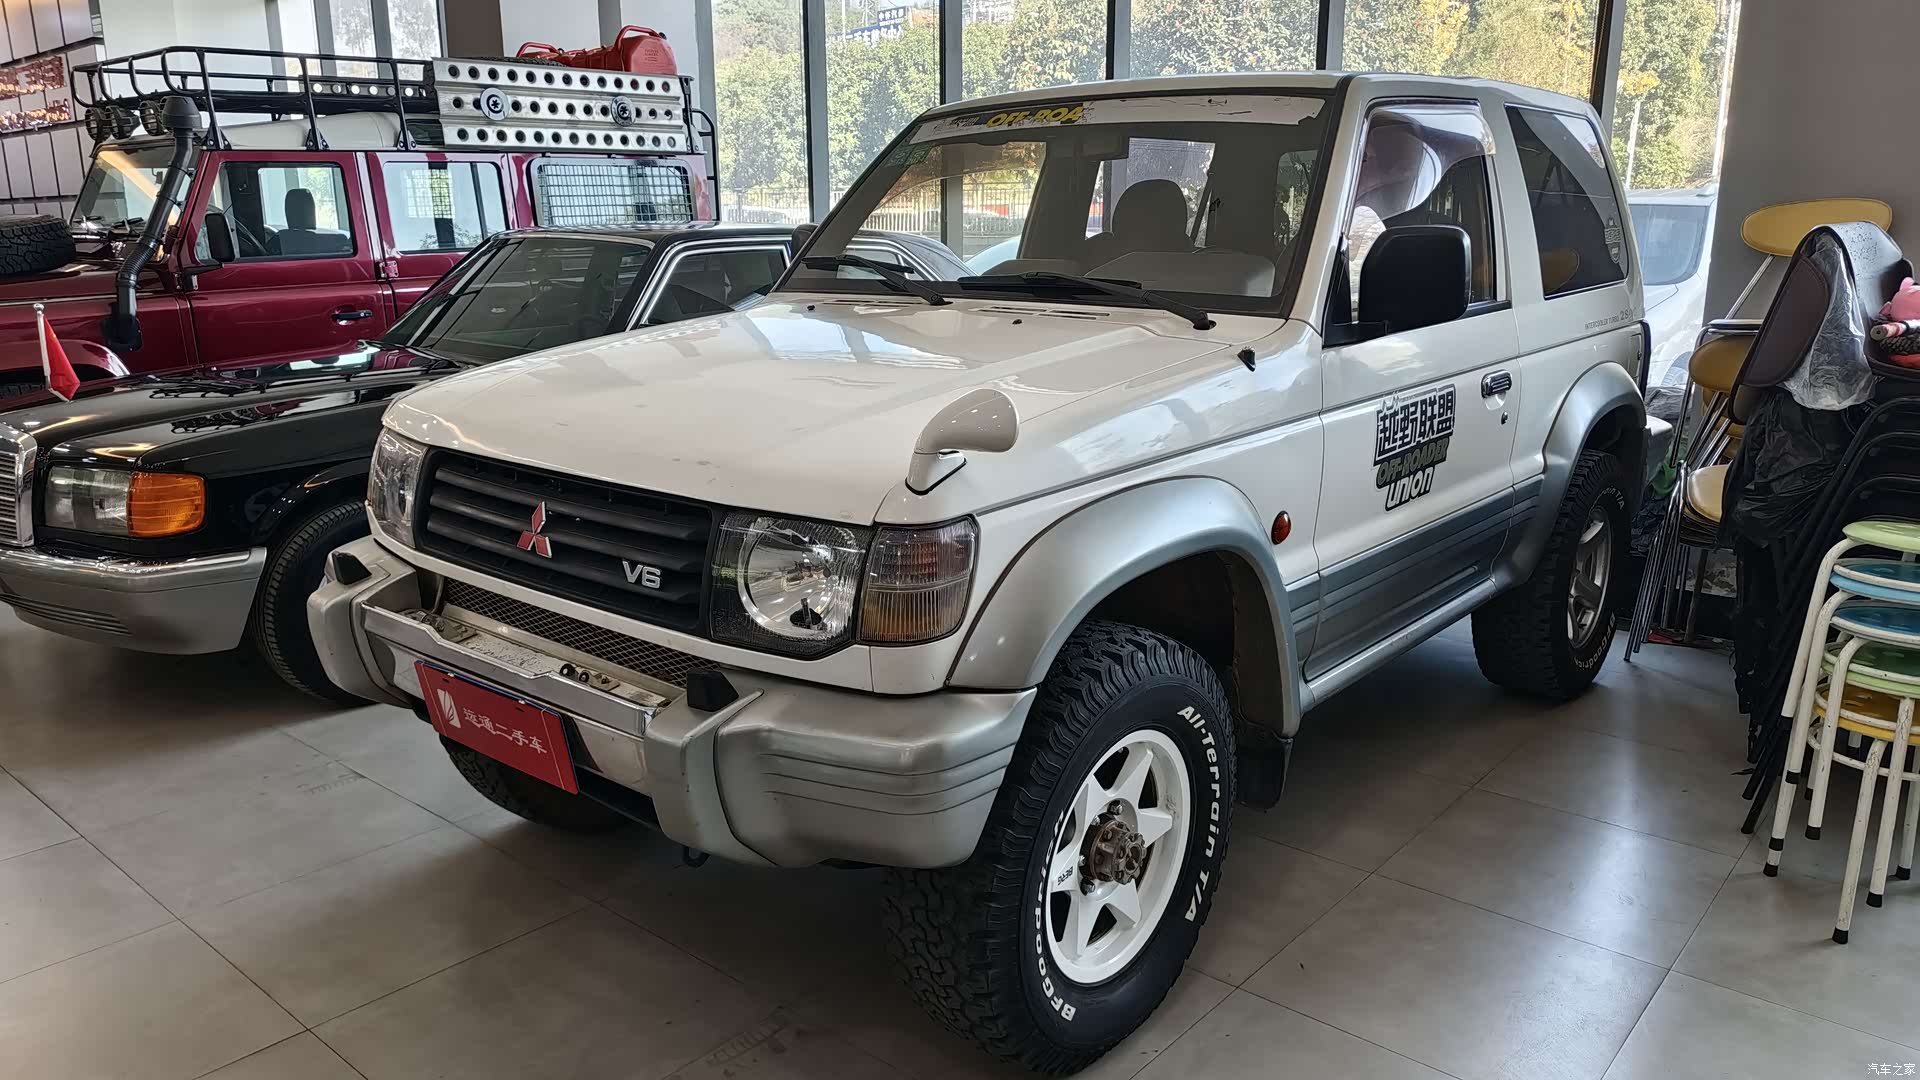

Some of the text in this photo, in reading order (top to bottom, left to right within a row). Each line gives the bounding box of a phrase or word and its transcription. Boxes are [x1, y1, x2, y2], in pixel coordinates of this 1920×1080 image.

[1375, 388, 1455, 460] 越野联盟
[1377, 437, 1450, 486] OFF-ROADER
[622, 560, 660, 588] V6
[1177, 705, 1222, 923] All-Terrain T/A
